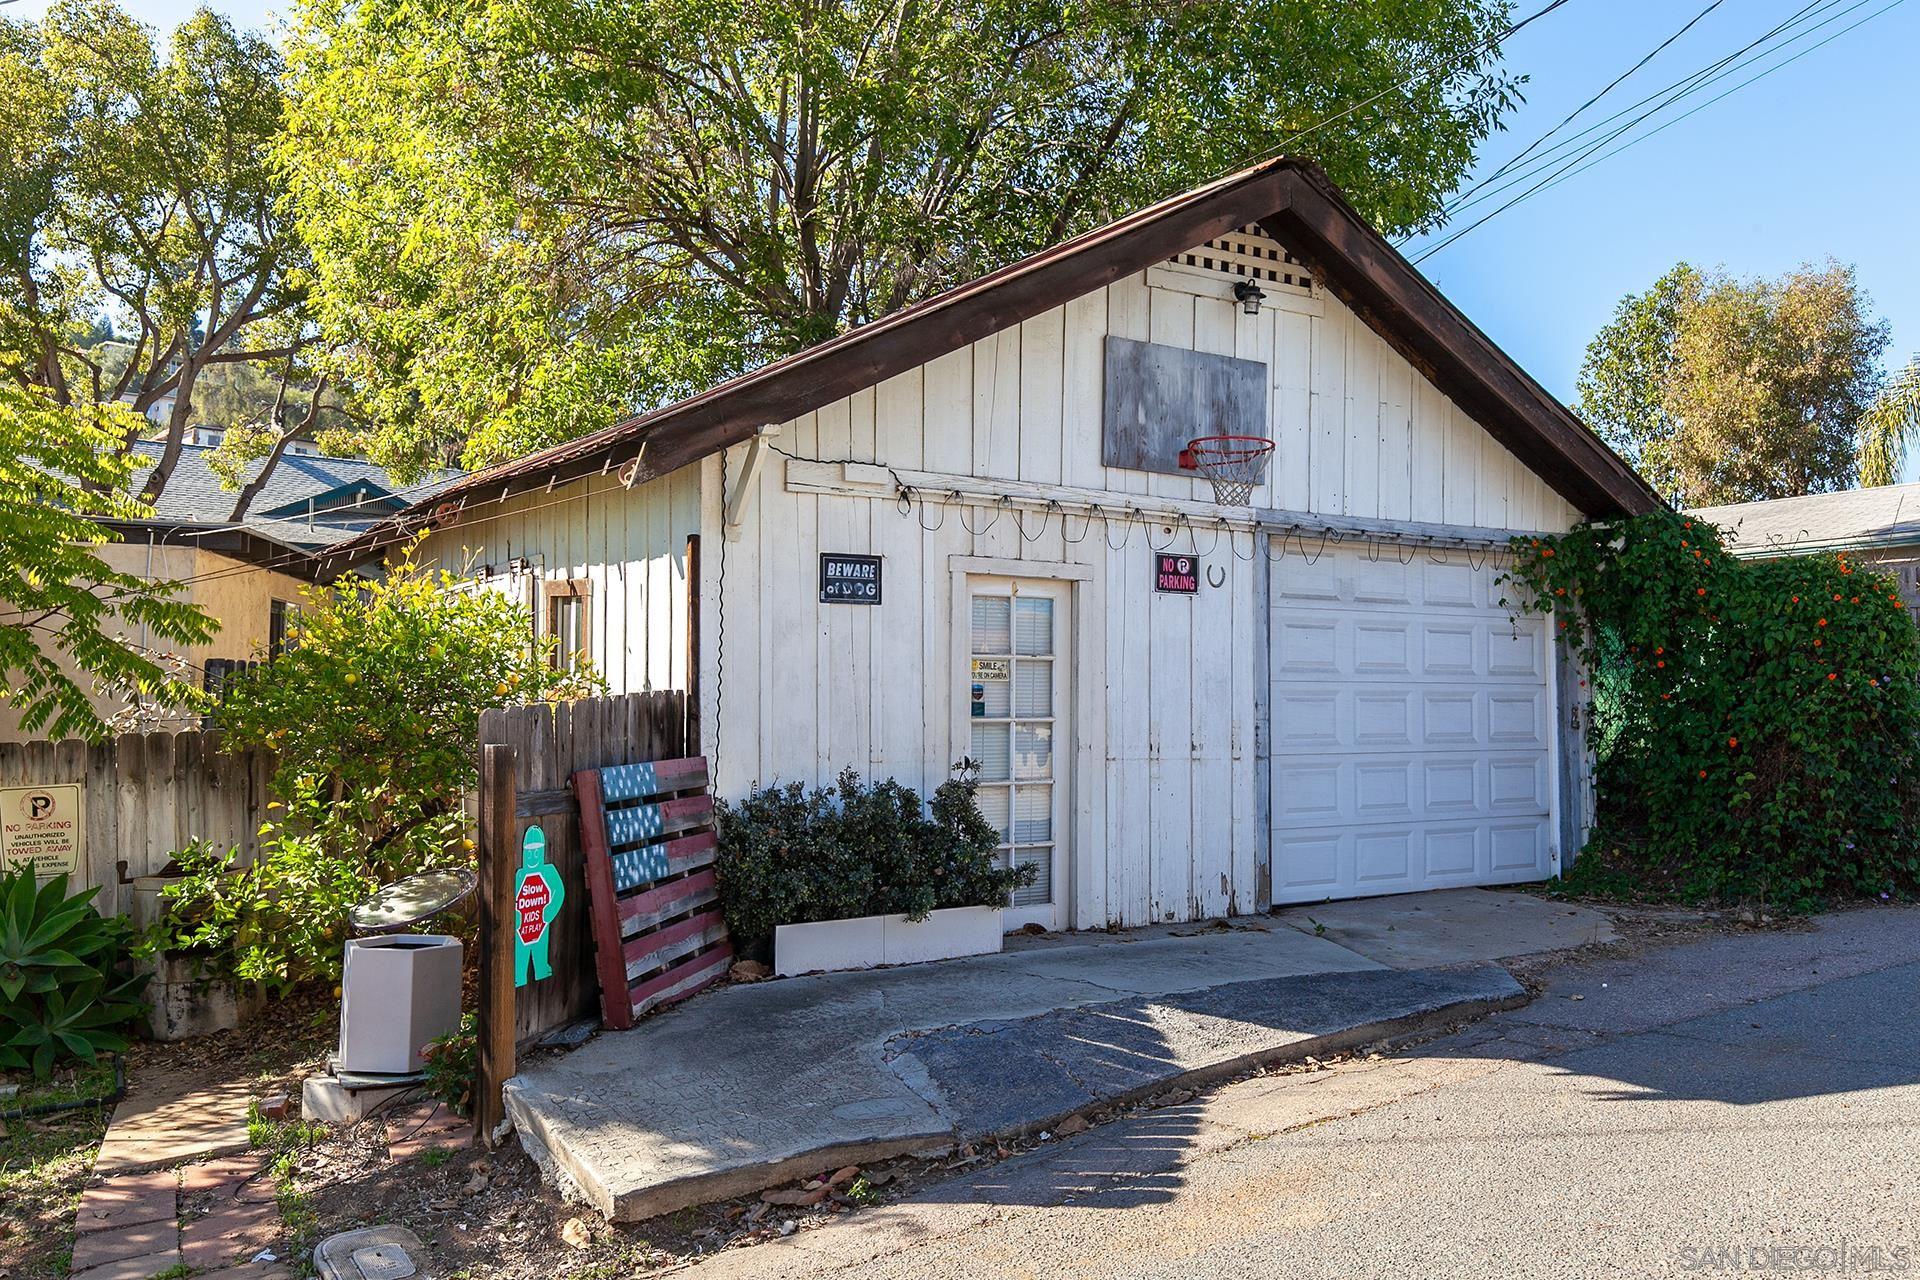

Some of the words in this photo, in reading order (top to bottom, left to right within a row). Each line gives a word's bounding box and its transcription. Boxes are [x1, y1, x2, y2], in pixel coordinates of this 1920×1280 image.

[827, 562, 876, 578] BEWARE
[1162, 558, 1175, 572] NO
[1159, 574, 1195, 590] PARKING
[979, 661, 998, 671] SMILE
[5, 824, 21, 833] NO
[25, 820, 72, 832] PARKING
[14, 832, 65, 840] UNAUTHORIZED
[6, 846, 42, 856] TOWED
[45, 844, 73, 853] AWAY
[32, 855, 59, 863] VEHICLE
[41, 861, 69, 869] EXPENSE
[522, 884, 544, 896] Slow
[518, 893, 547, 910] Down!
[523, 910, 540, 924] KIDS
[520, 925, 529, 936] AT
[528, 922, 543, 934] PLAY
